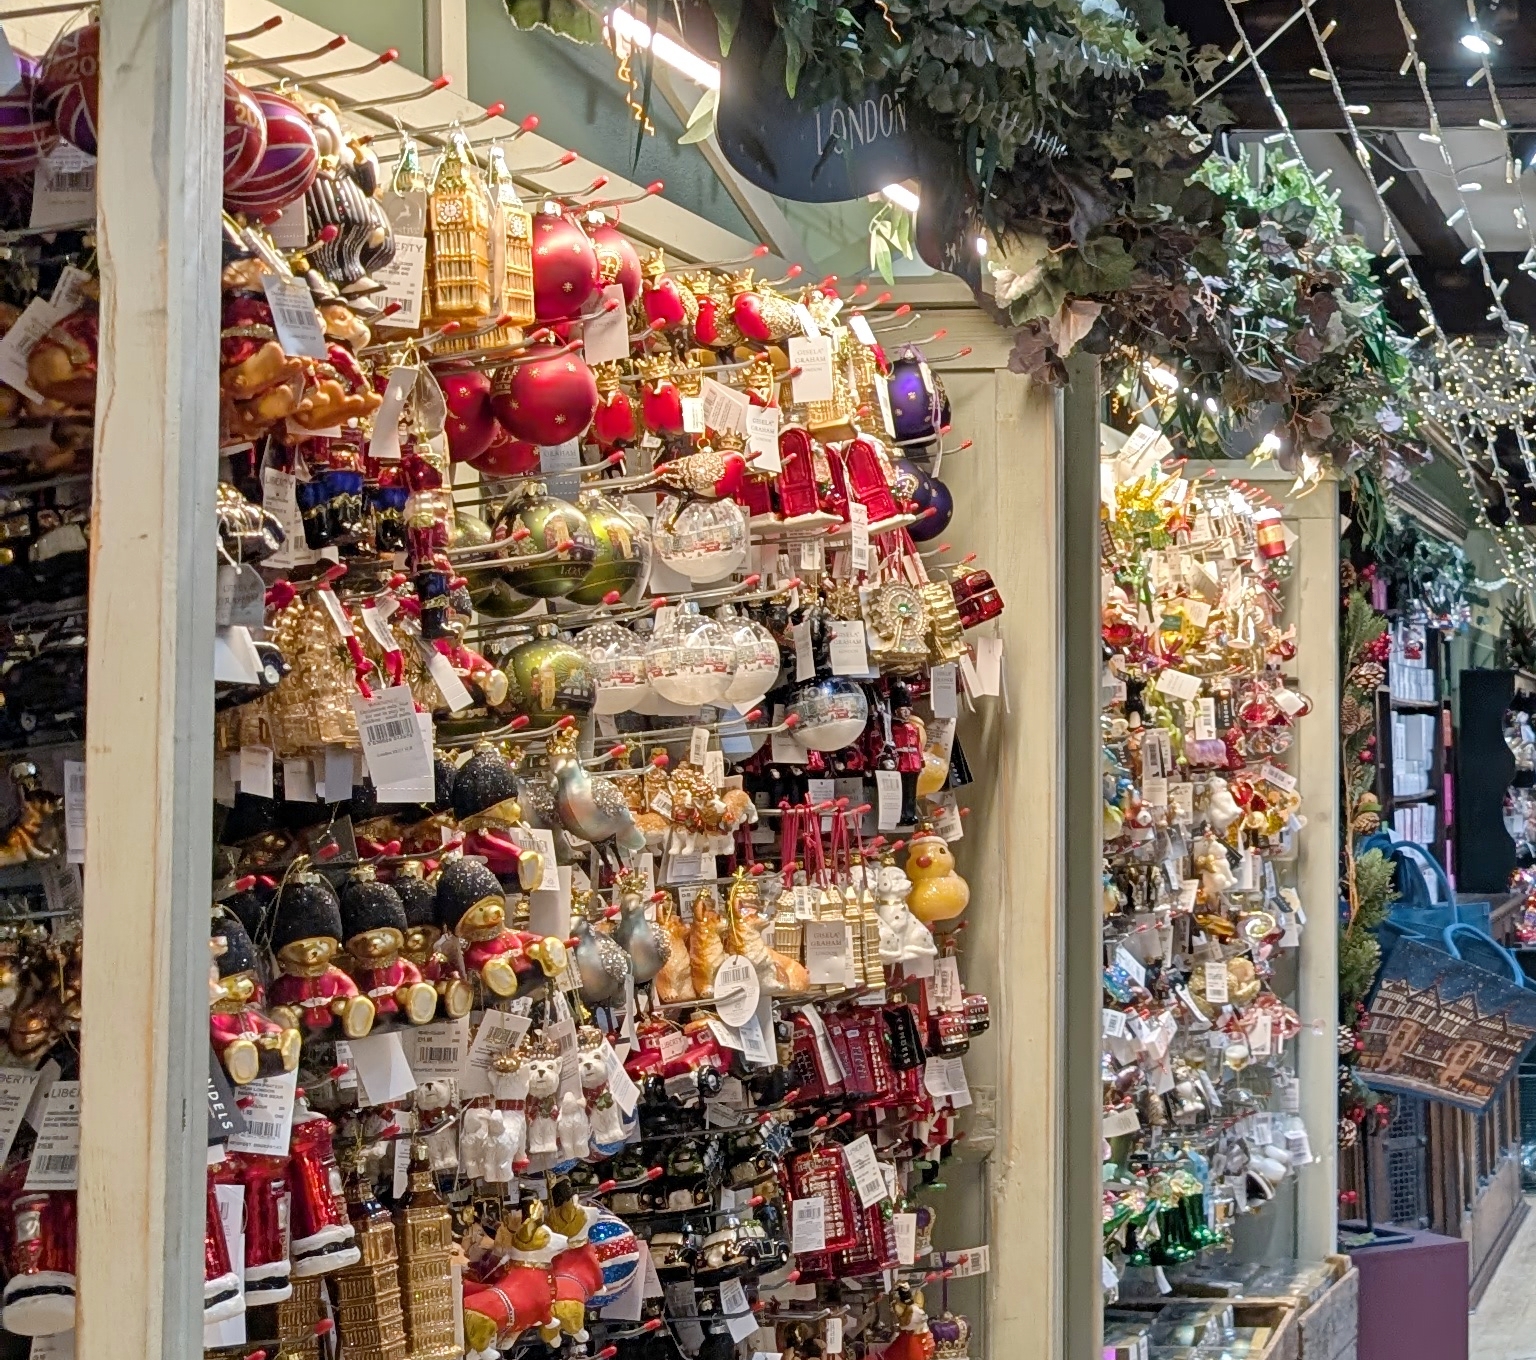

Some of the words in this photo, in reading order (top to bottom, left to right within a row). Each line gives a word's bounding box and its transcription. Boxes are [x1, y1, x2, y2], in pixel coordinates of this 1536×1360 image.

[815, 94, 907, 156] LONDON
[795, 356, 827, 364] GRAHAM
[51, 1088, 80, 1098] LIBE
[208, 1078, 234, 1130] NDELS
